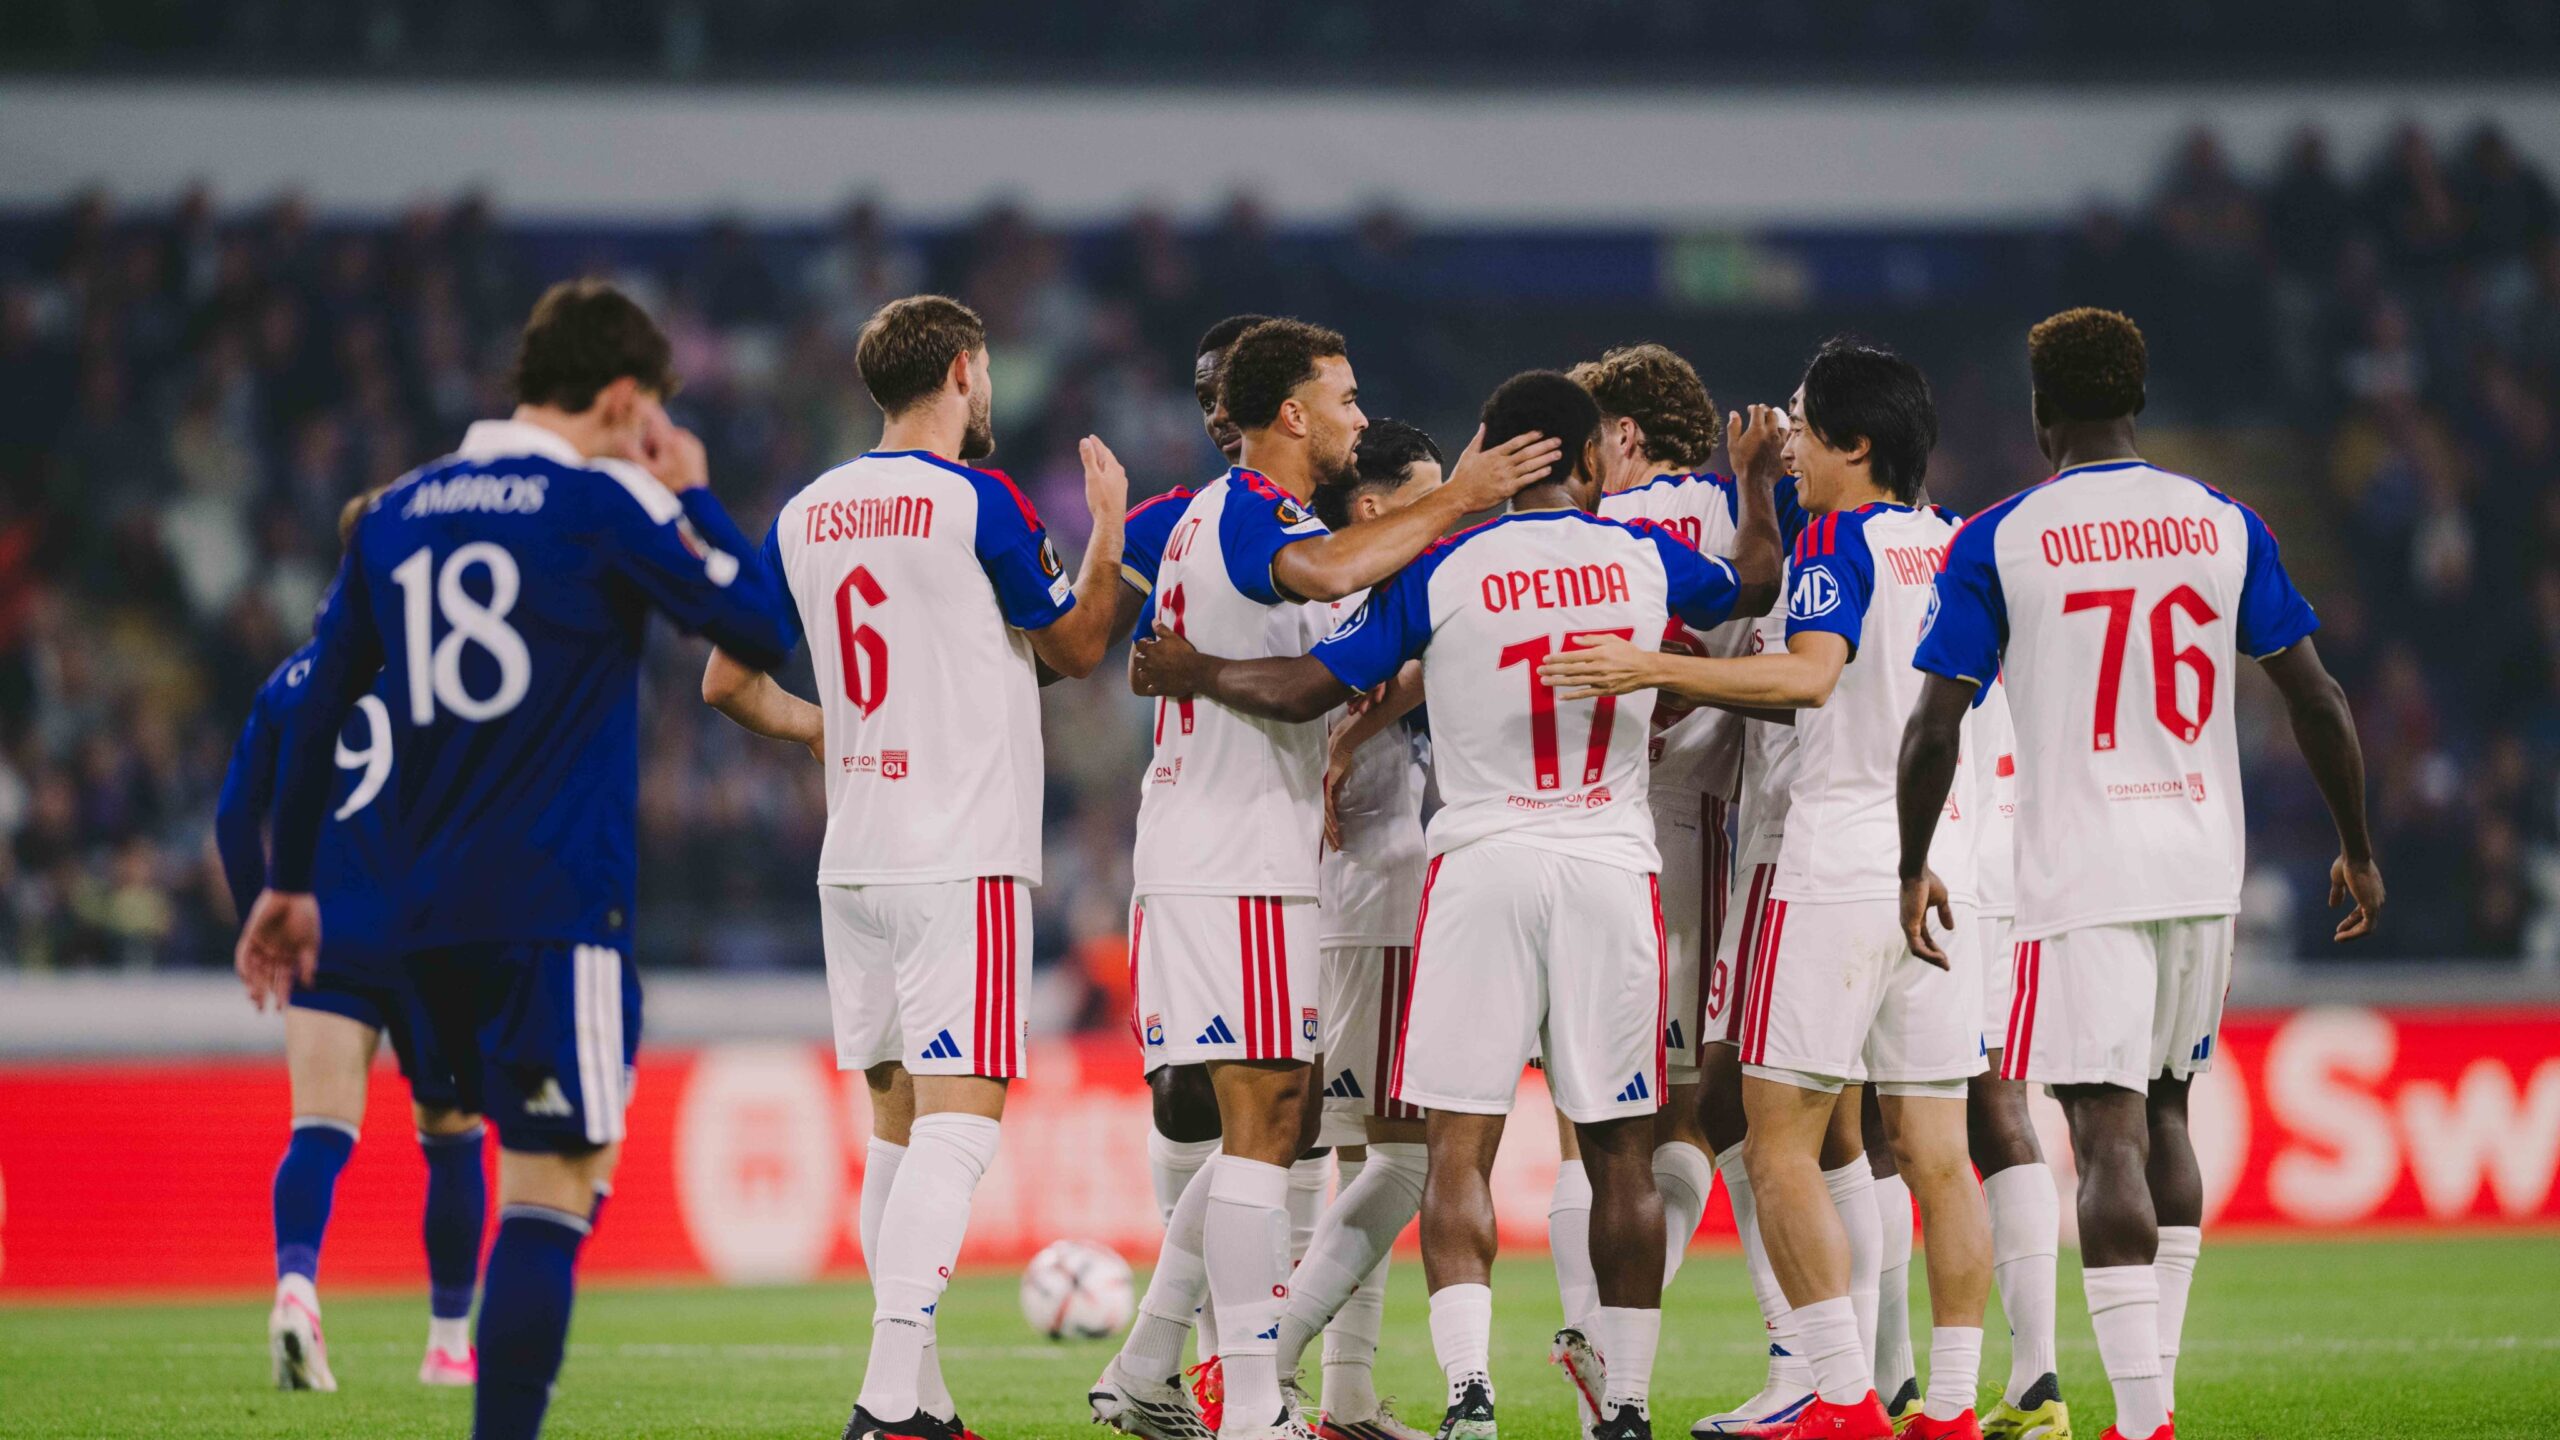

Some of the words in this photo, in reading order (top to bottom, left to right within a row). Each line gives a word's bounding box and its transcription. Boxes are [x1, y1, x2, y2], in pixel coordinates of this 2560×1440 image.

[806, 496, 934, 545] TESSMANN
[2041, 516, 2219, 567] OUEDRAOGO
[1481, 562, 1631, 614] OPENDA
[1790, 570, 1838, 616] MG
[392, 541, 532, 726] 18
[835, 564, 888, 720] 6
[2063, 583, 2220, 752] 76
[1497, 627, 1635, 792] 17
[334, 694, 393, 822] 9
[2106, 781, 2183, 796] FONDATION
